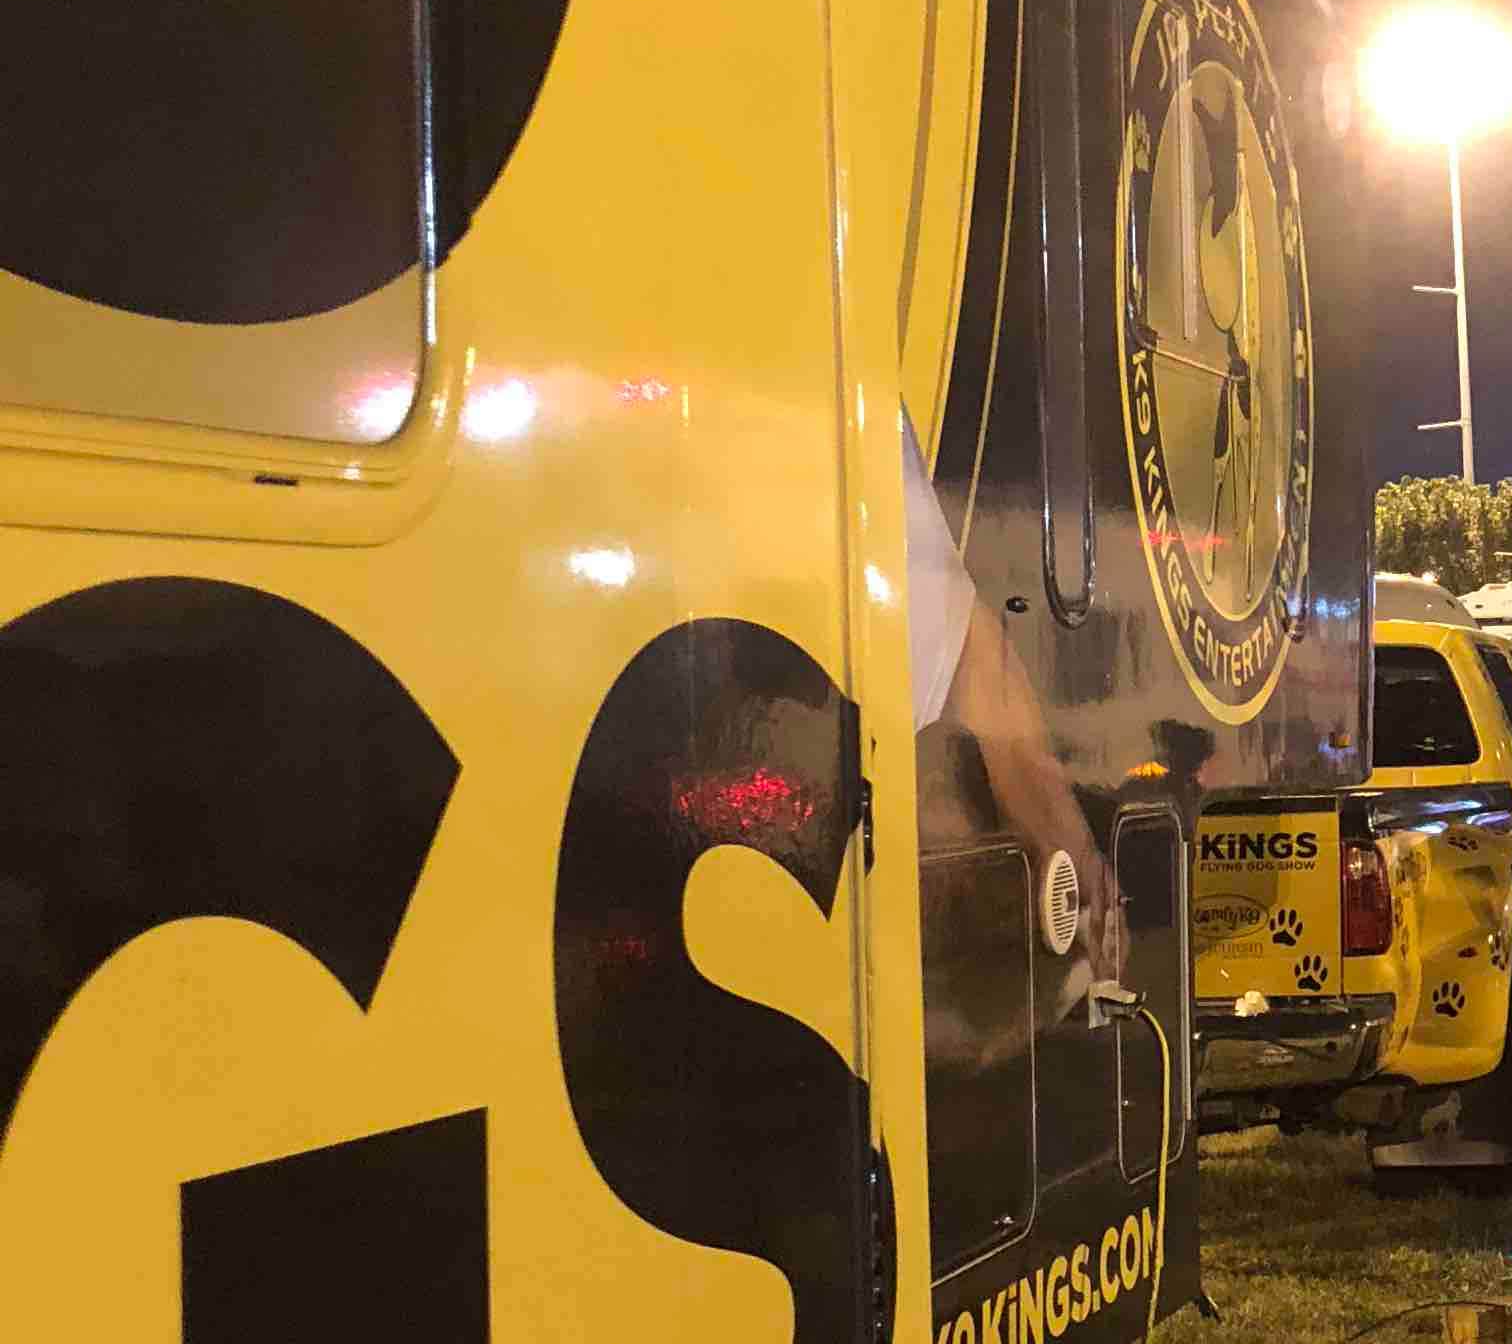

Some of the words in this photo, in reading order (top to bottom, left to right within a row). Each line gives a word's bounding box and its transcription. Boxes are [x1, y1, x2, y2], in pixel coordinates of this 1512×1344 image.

[1132, 349, 1153, 437] K9
[1142, 445, 1193, 632] KINGS
[1200, 861, 1242, 873] FLYING
[1278, 860, 1316, 872] SHOW
